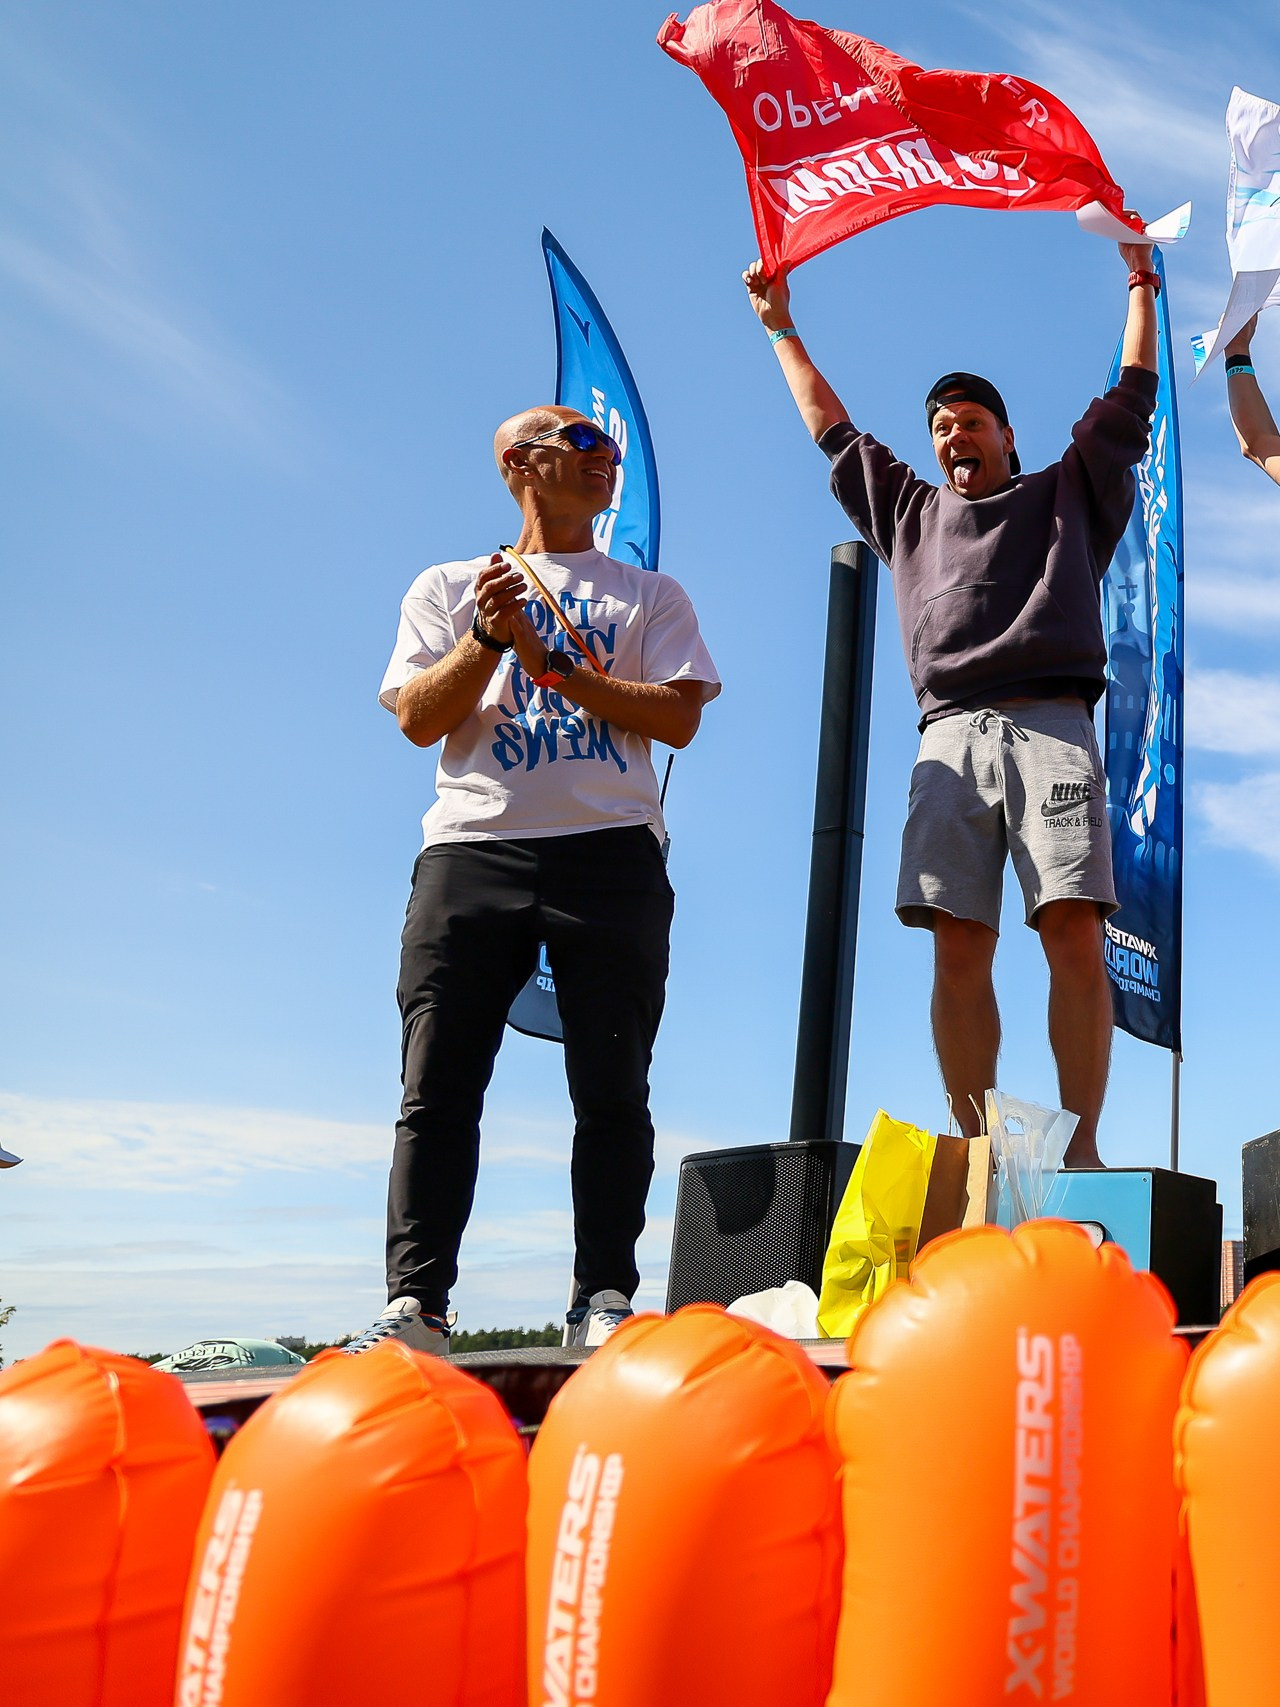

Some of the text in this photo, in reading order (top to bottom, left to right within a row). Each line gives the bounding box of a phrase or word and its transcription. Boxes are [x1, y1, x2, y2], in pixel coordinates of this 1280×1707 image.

[492, 714, 628, 775] SWIM
[1050, 783, 1091, 801] NIKE
[1044, 817, 1073, 828] TRACK
[1052, 1332, 1083, 1701] WORLD CHAMPIONSHIP
